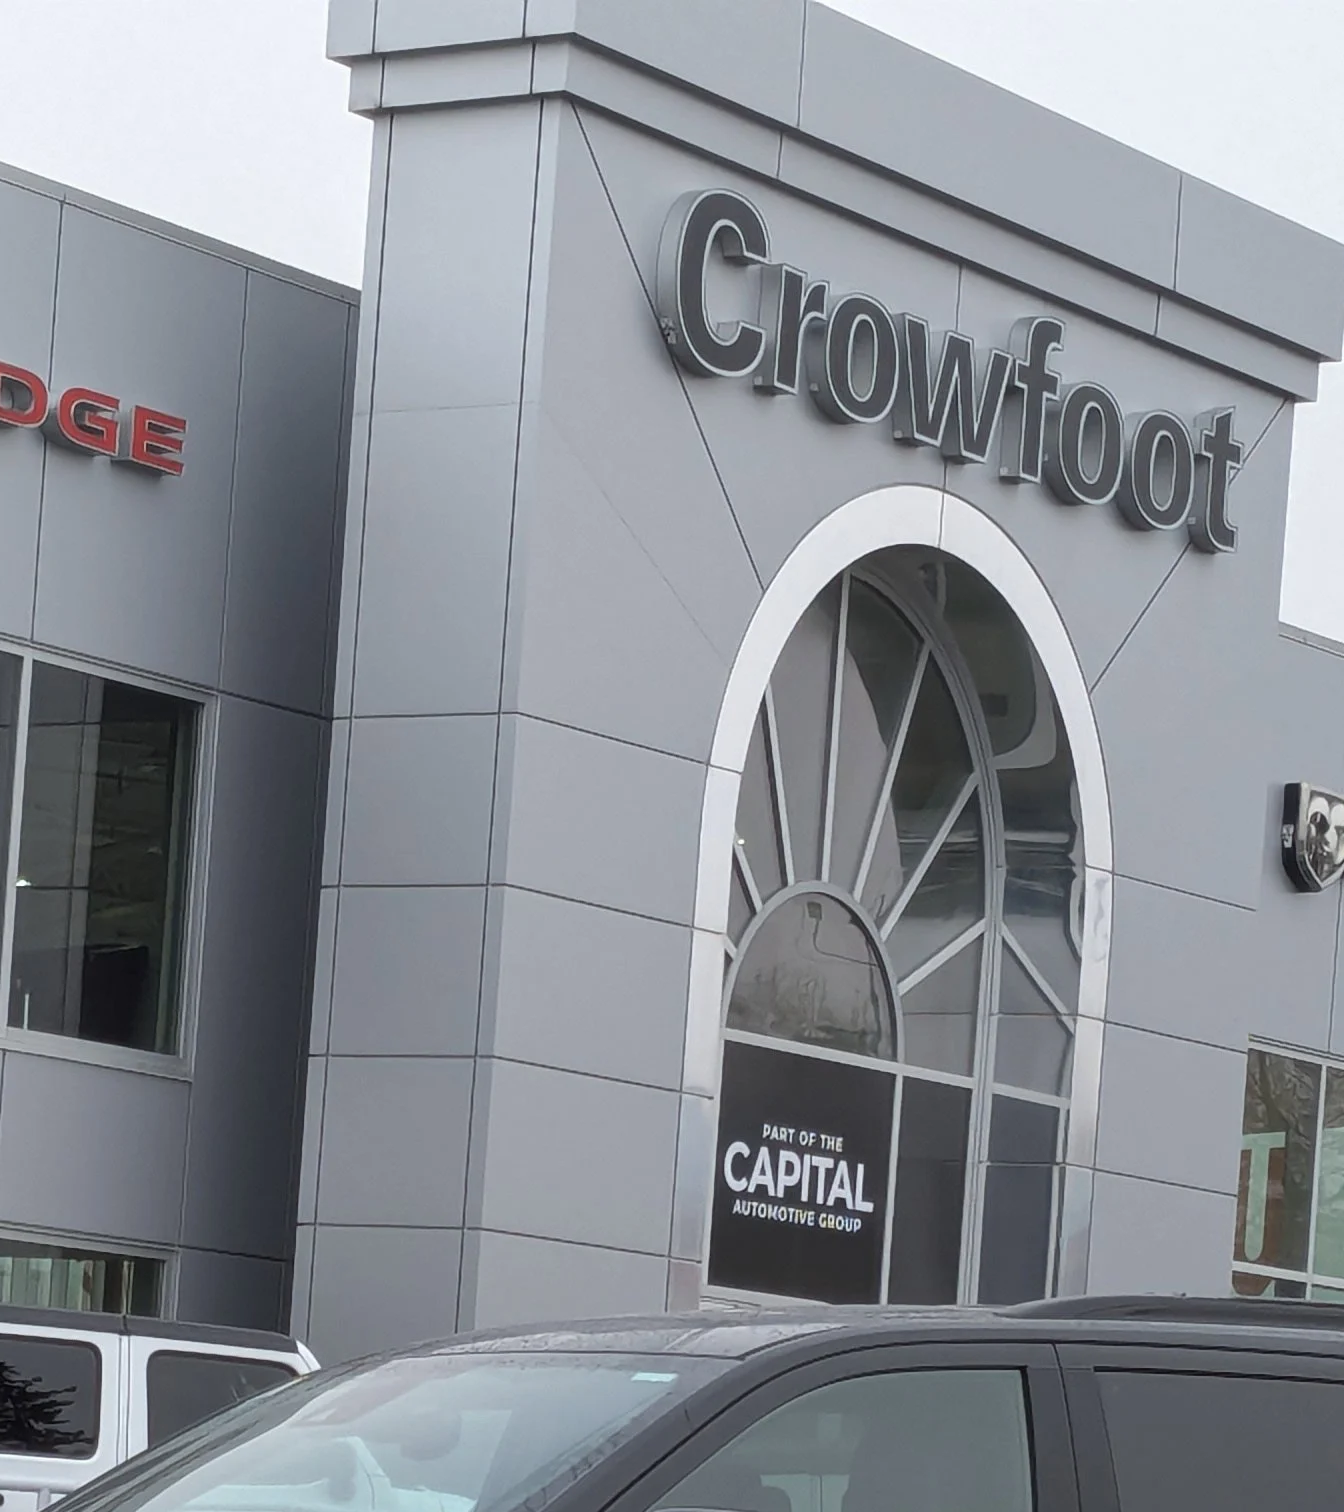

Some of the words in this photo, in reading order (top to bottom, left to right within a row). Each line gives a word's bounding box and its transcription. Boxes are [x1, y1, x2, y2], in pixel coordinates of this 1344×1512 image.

[672, 188, 1244, 554] Crowfoot
[762, 1123, 795, 1143] PART
[799, 1130, 816, 1147] OF
[820, 1134, 844, 1152] THE
[724, 1141, 874, 1213] CAPITAL
[732, 1199, 815, 1226] AUTOMOTIVE
[819, 1213, 862, 1233] GROUP
